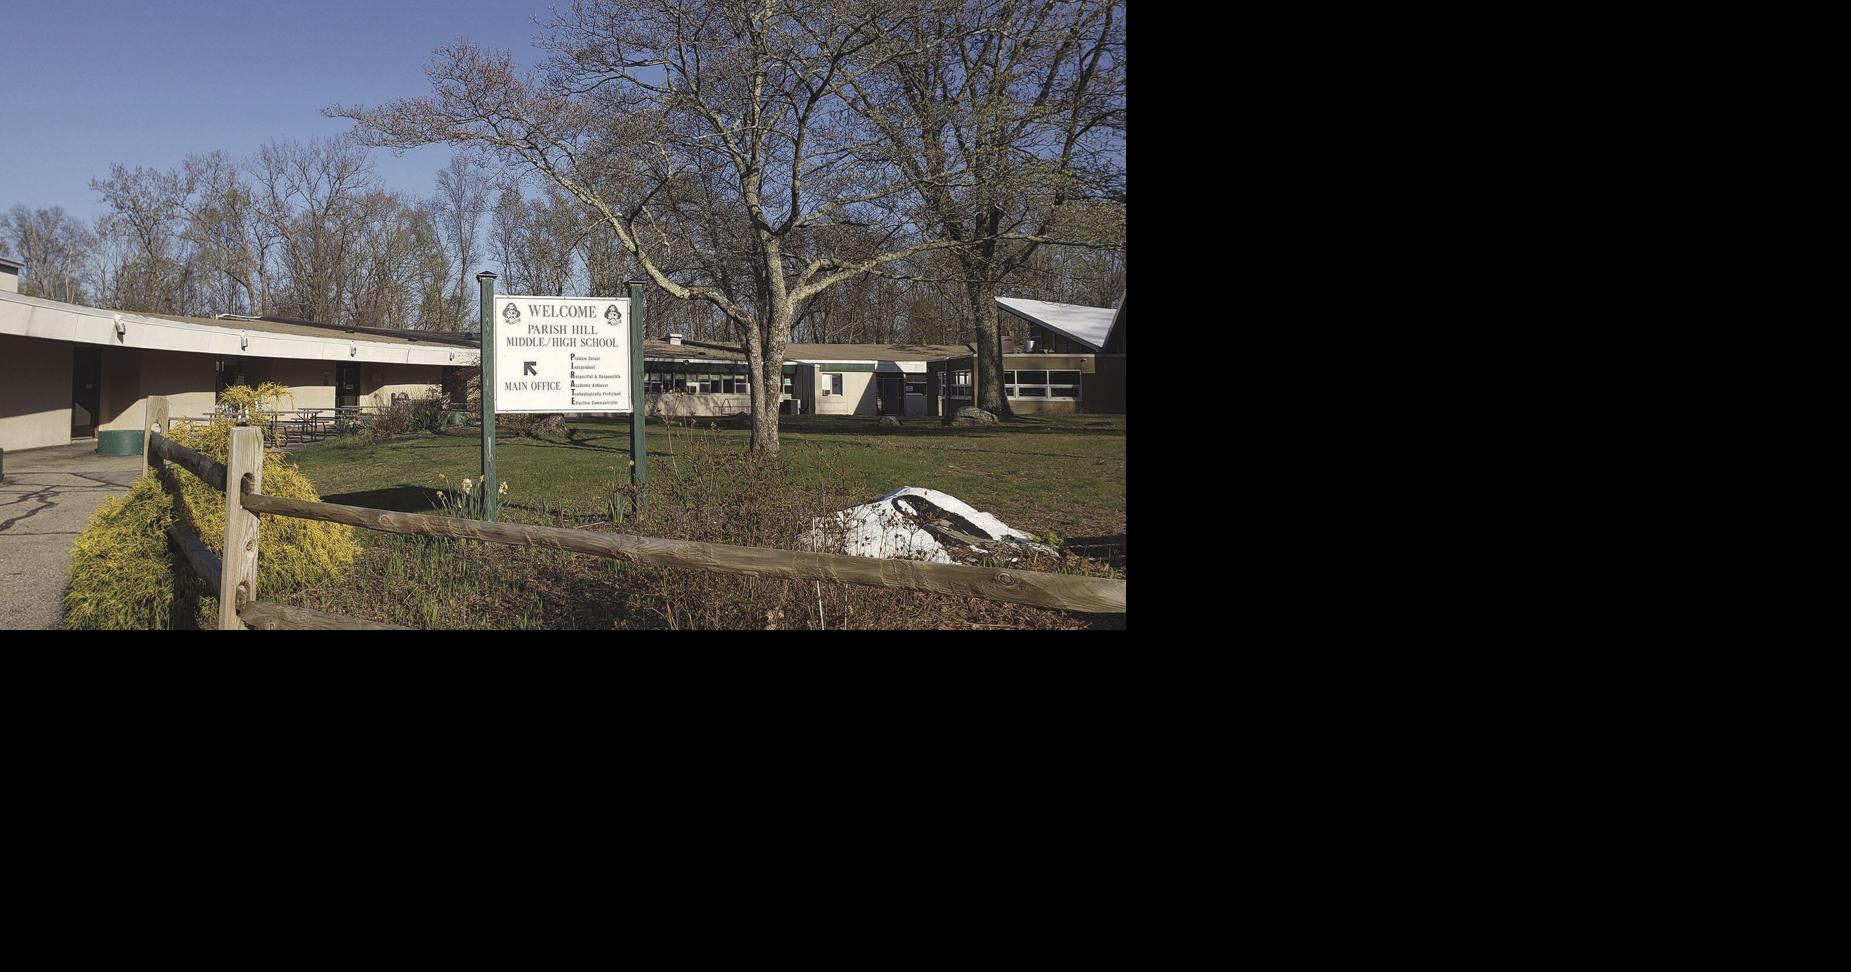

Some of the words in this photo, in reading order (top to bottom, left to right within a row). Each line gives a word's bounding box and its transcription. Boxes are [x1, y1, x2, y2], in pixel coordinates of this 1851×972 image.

[528, 305, 597, 318] WELCOME
[528, 324, 567, 334] PARISH
[572, 325, 598, 335] HILL
[506, 336, 577, 347] MIDDLE/HIGH
[580, 337, 618, 348] SCHOOL
[505, 381, 528, 391] MAIN
[531, 381, 561, 391] OFFICE
